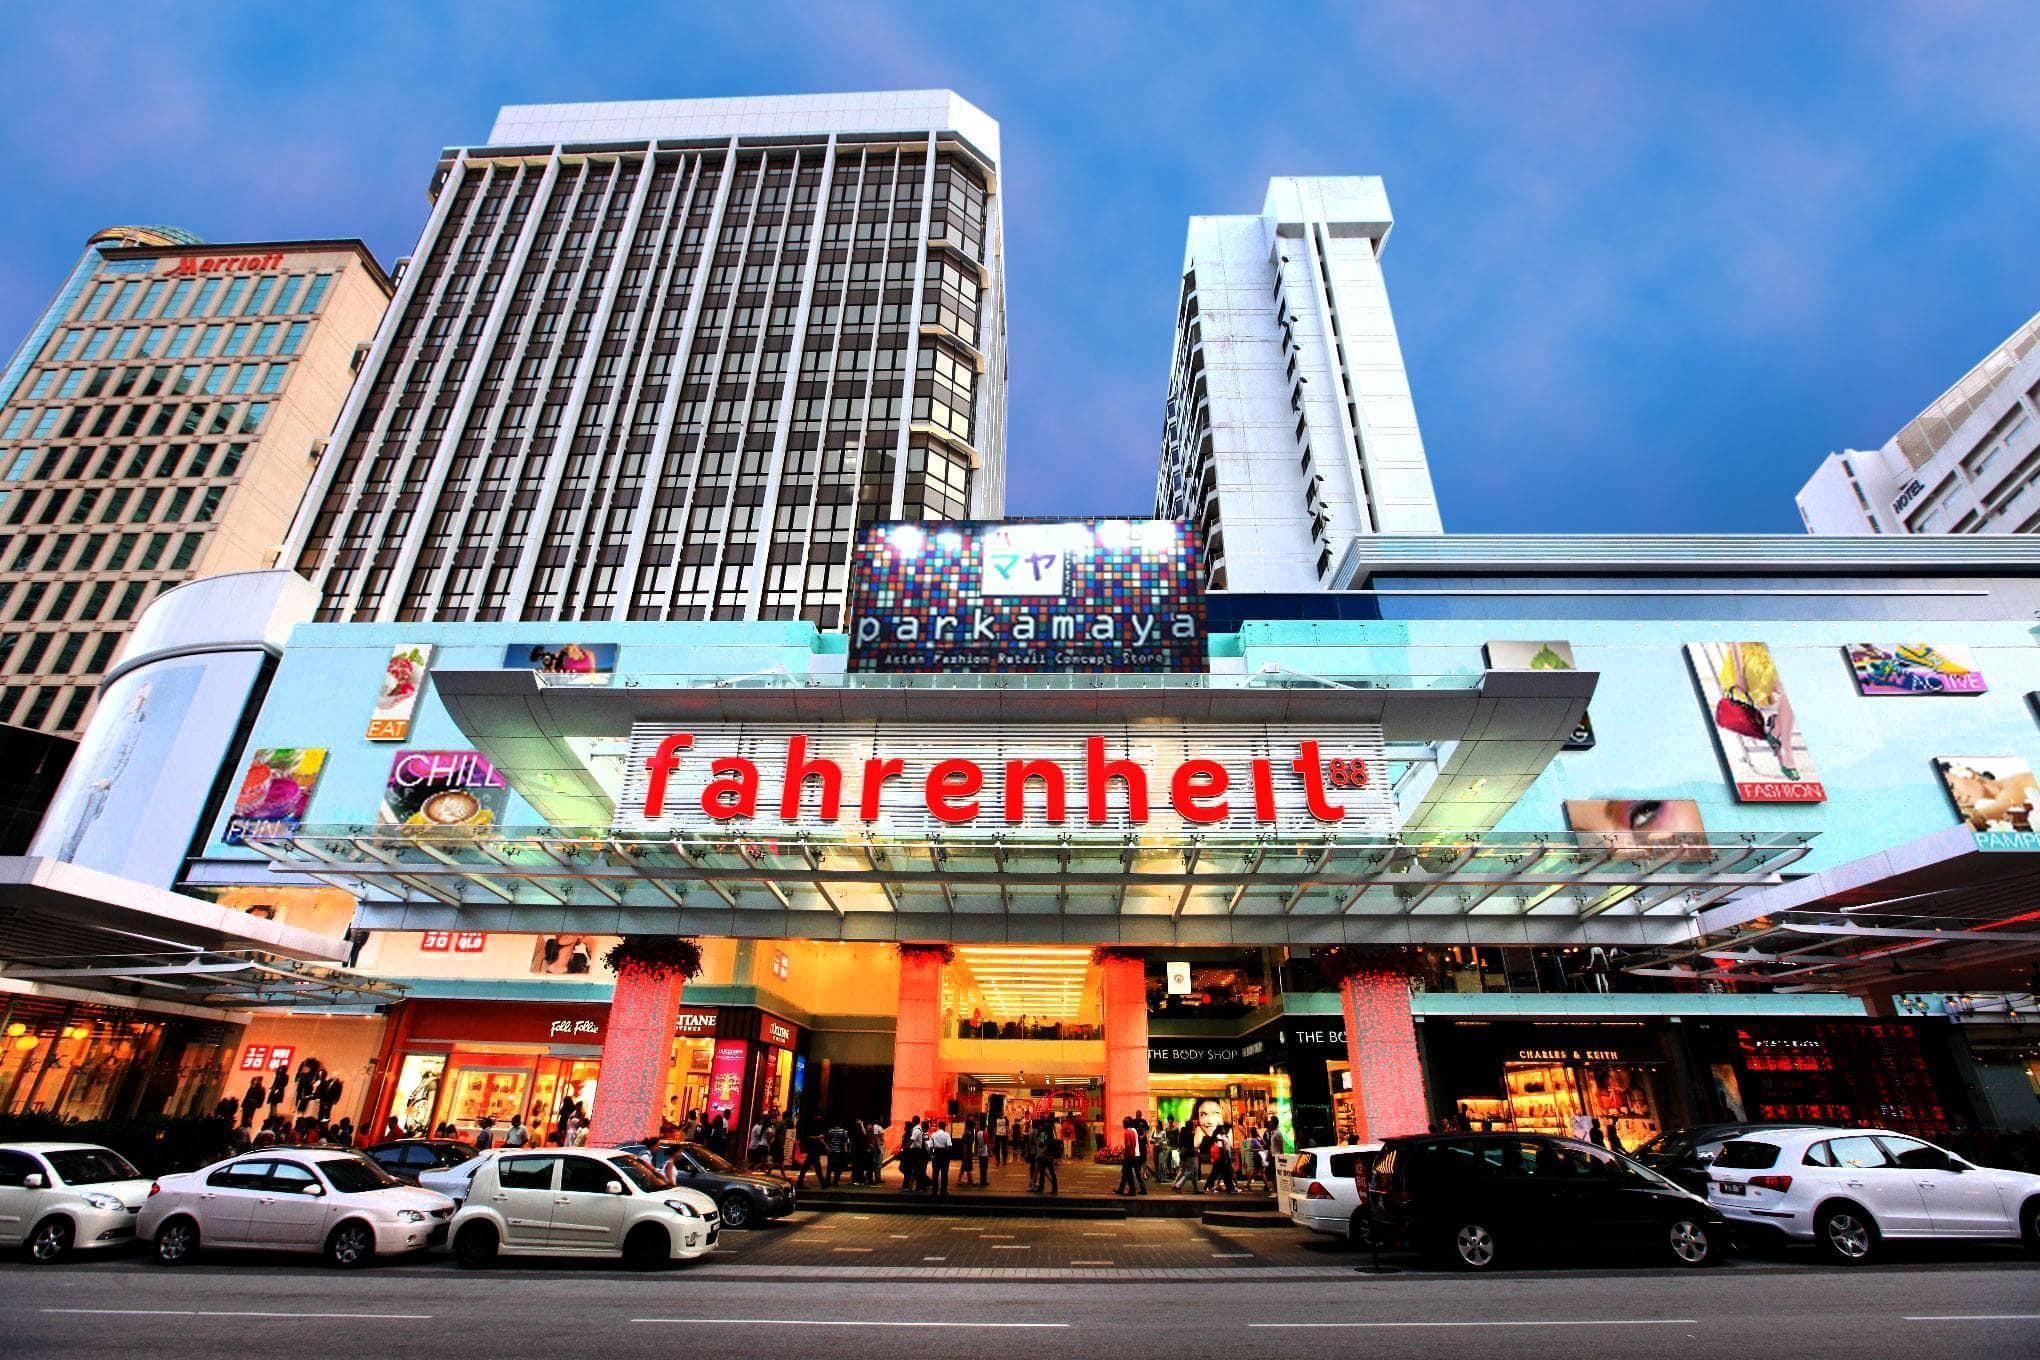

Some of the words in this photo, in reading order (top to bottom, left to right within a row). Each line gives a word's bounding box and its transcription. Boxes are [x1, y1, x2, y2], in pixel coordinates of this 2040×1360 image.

[163, 251, 284, 276] Marriott
[1892, 479, 1925, 514] HOTEL
[857, 608, 1195, 648] parkamaya
[1055, 653, 1113, 667] Concept
[367, 721, 408, 737] EAT
[395, 754, 501, 787] CHILL
[643, 734, 1346, 823] fahrenheit
[1330, 758, 1368, 786] 88
[1743, 783, 1823, 798] FASHION
[1296, 1031, 1324, 1043] THE
[1148, 1050, 1169, 1060] THE
[1172, 1050, 1203, 1060] BODY
[1207, 1050, 1238, 1061] SHOP
[1519, 1050, 1567, 1059] CHARLES
[1573, 1050, 1581, 1060] &
[1586, 1051, 1618, 1060] KEITH
